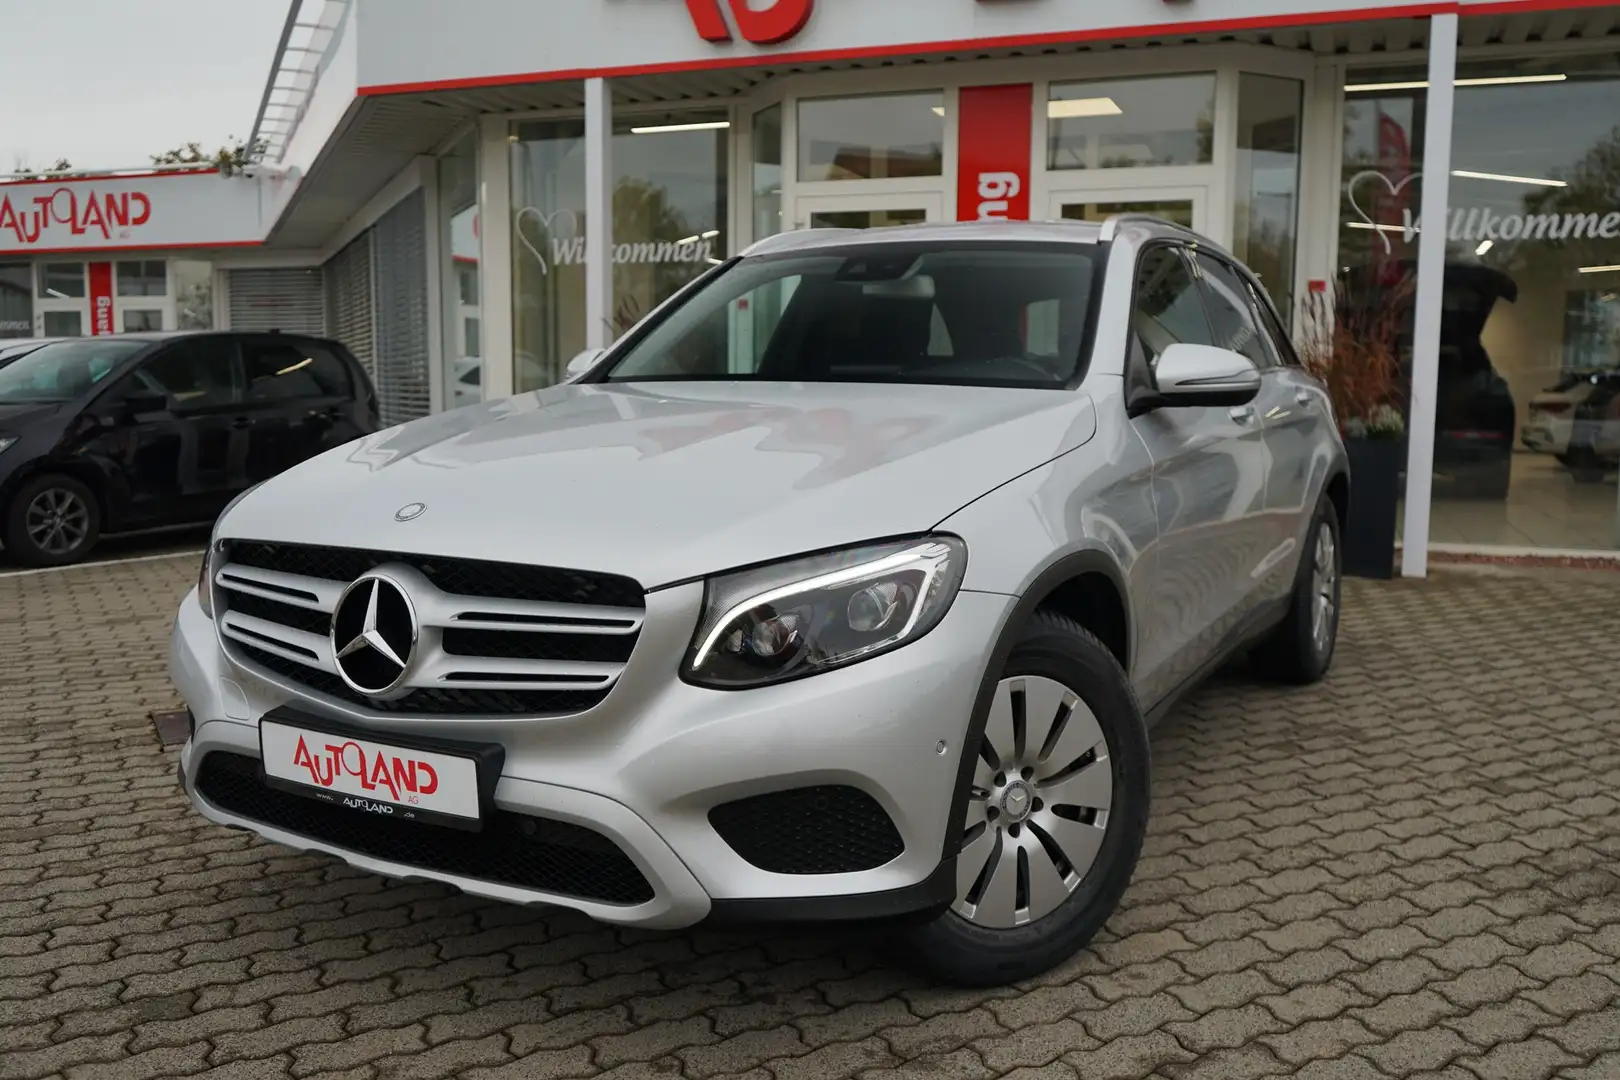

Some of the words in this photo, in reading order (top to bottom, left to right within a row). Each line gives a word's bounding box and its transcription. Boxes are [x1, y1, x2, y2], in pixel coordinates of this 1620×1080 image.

[0, 188, 151, 243] AUTOLAND
[552, 236, 715, 265] Wiommen
[294, 735, 438, 801] AUTOLAND
[343, 797, 394, 814] AUTOLAND
